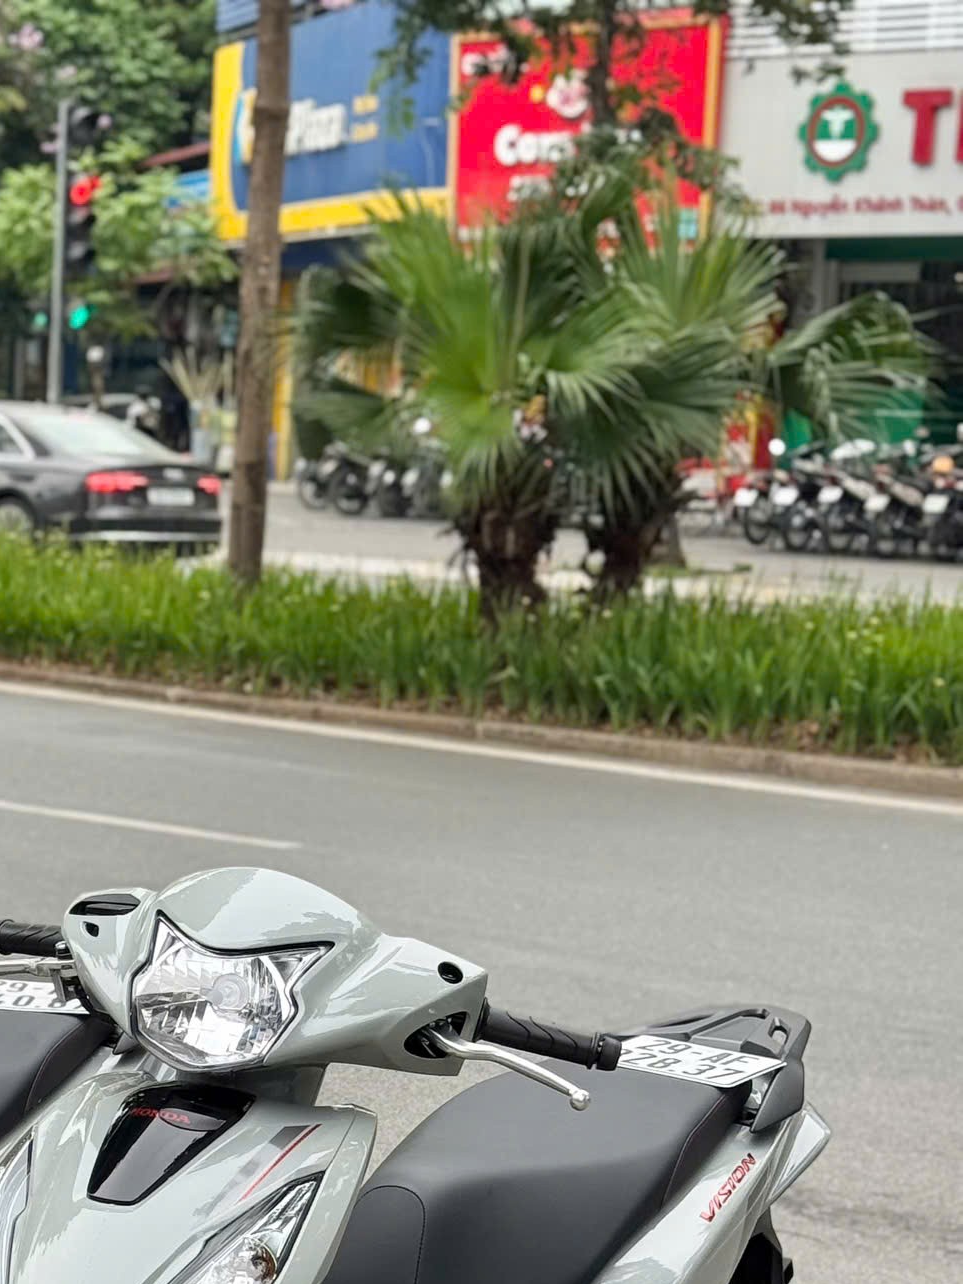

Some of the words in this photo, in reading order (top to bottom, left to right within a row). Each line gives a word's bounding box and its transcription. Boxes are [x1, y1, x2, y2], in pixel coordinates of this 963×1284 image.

[902, 89, 963, 167] T
[637, 1039, 760, 1067] 29-AF
[130, 1105, 191, 1125] HONDA
[699, 1152, 756, 1223] VISION
